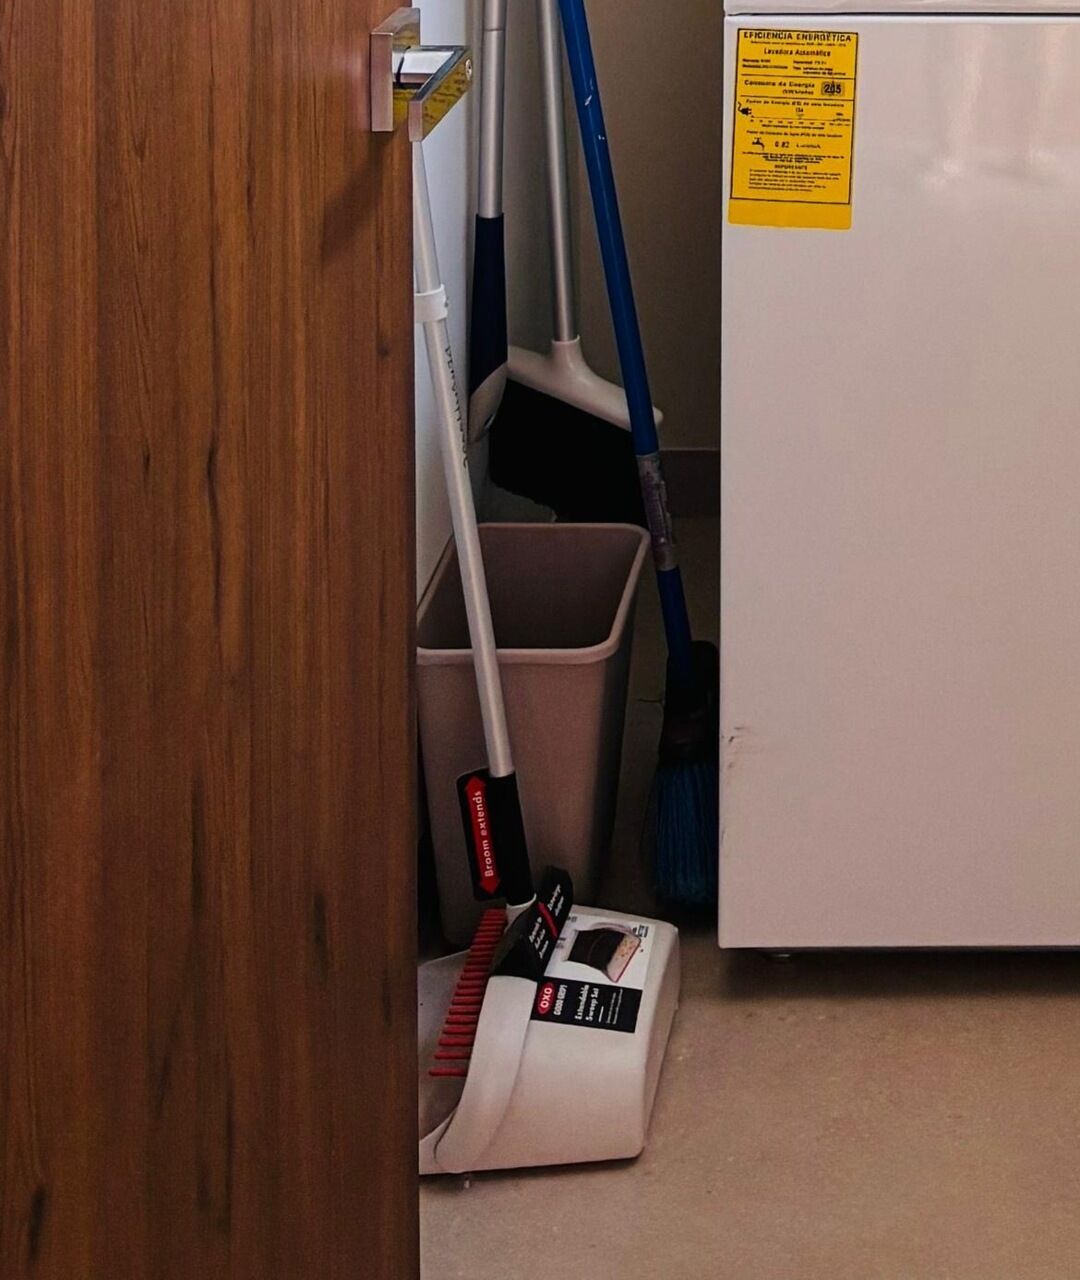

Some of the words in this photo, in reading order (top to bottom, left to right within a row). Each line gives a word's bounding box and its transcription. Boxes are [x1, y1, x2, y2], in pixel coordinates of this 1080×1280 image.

[744, 31, 793, 40] EFICIENCIA
[472, 790, 488, 836] extends
[482, 840, 494, 878] Broom
[540, 987, 553, 1008] OXO
